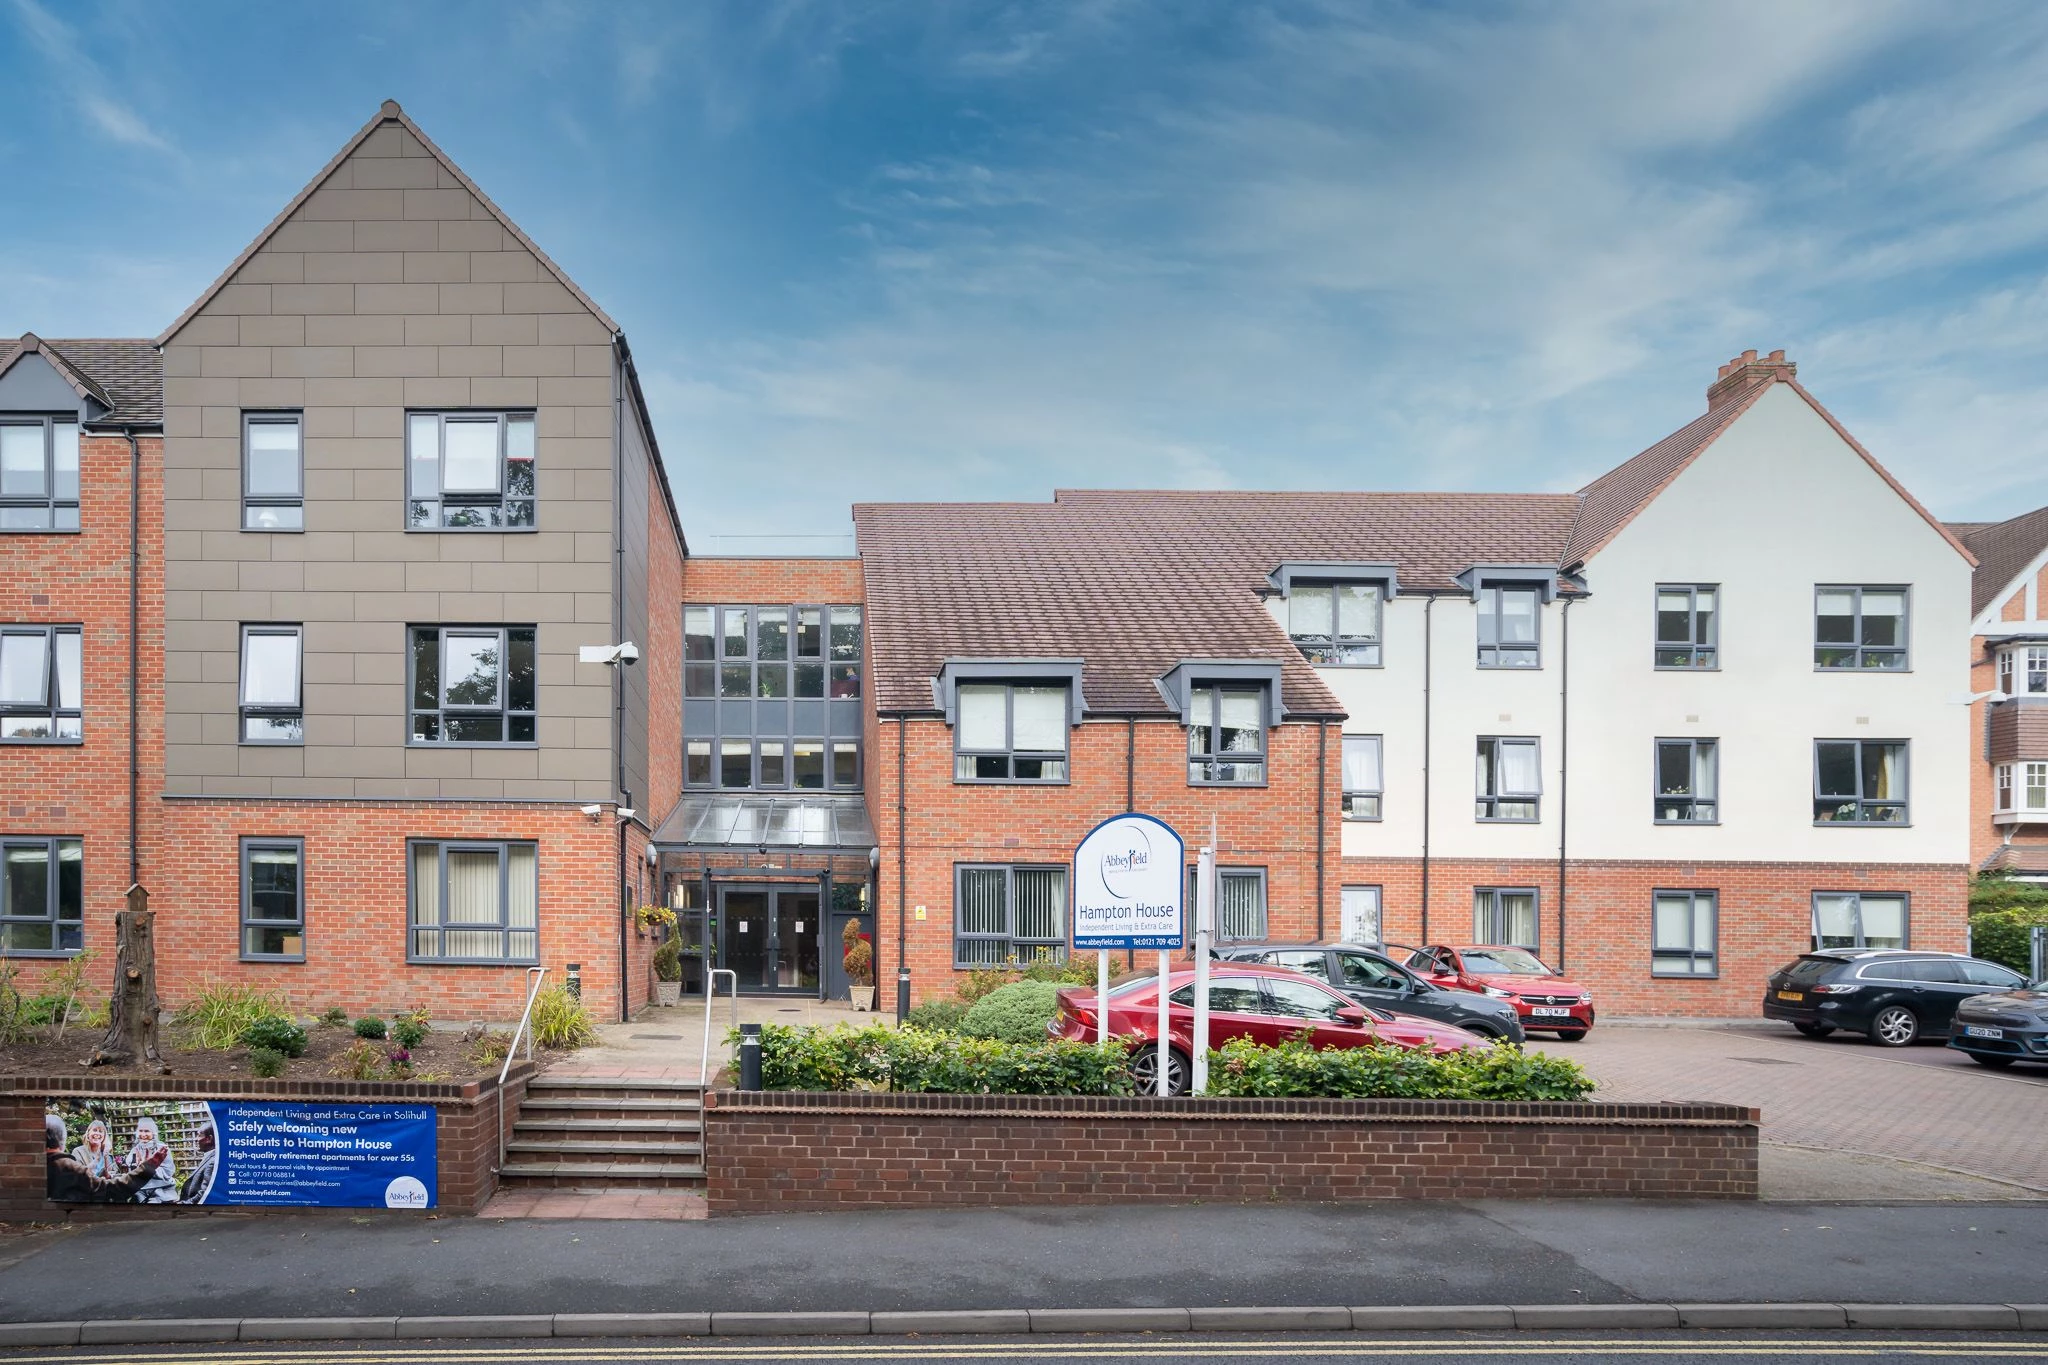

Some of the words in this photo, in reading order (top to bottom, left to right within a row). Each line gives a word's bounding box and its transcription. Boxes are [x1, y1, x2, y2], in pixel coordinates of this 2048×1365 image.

[1080, 905, 1131, 922] Hampton
[1137, 903, 1173, 917] House
[1116, 923, 1132, 932] Living
[229, 1107, 283, 1118] Independent
[286, 1110, 311, 1120] Living
[334, 1111, 355, 1119] Extra
[359, 1111, 380, 1119] Care
[384, 1111, 391, 1119] in
[395, 1111, 427, 1119] Solihull
[229, 1121, 263, 1134] Safely
[267, 1122, 329, 1136] welcoming
[229, 1136, 280, 1147] residents
[284, 1138, 294, 1147] to
[298, 1138, 351, 1151] Hampton
[356, 1139, 392, 1149] House
[229, 1151, 277, 1160] High-quality
[389, 1191, 424, 1204] Abbeyfield
